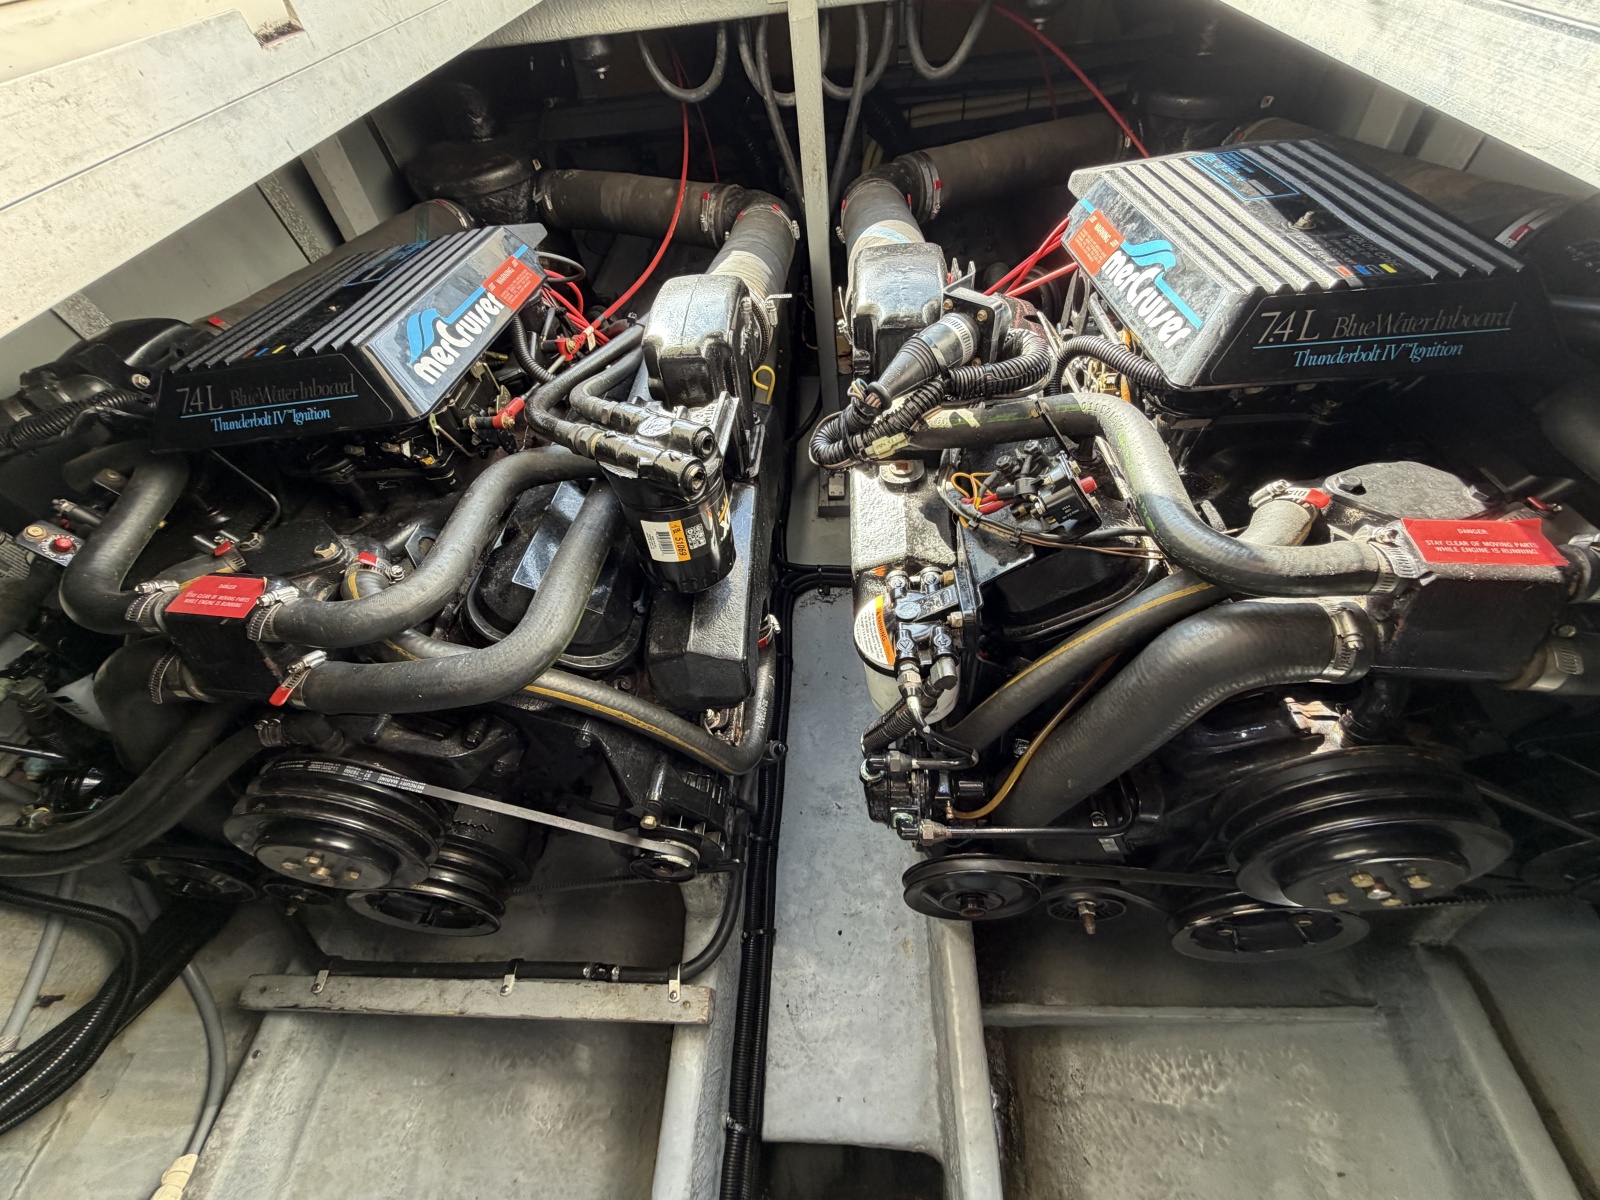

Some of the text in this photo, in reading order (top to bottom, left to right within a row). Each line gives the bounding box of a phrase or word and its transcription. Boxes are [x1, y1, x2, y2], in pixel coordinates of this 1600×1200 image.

[495, 266, 515, 285] WARNING
[1294, 344, 1381, 367] Thunderbolt
[1409, 341, 1463, 363] Ignition
[211, 411, 272, 432] Thunderbolt
[292, 406, 331, 426] Ignition
[675, 537, 687, 556] 51069
[877, 615, 888, 641] WARNING
